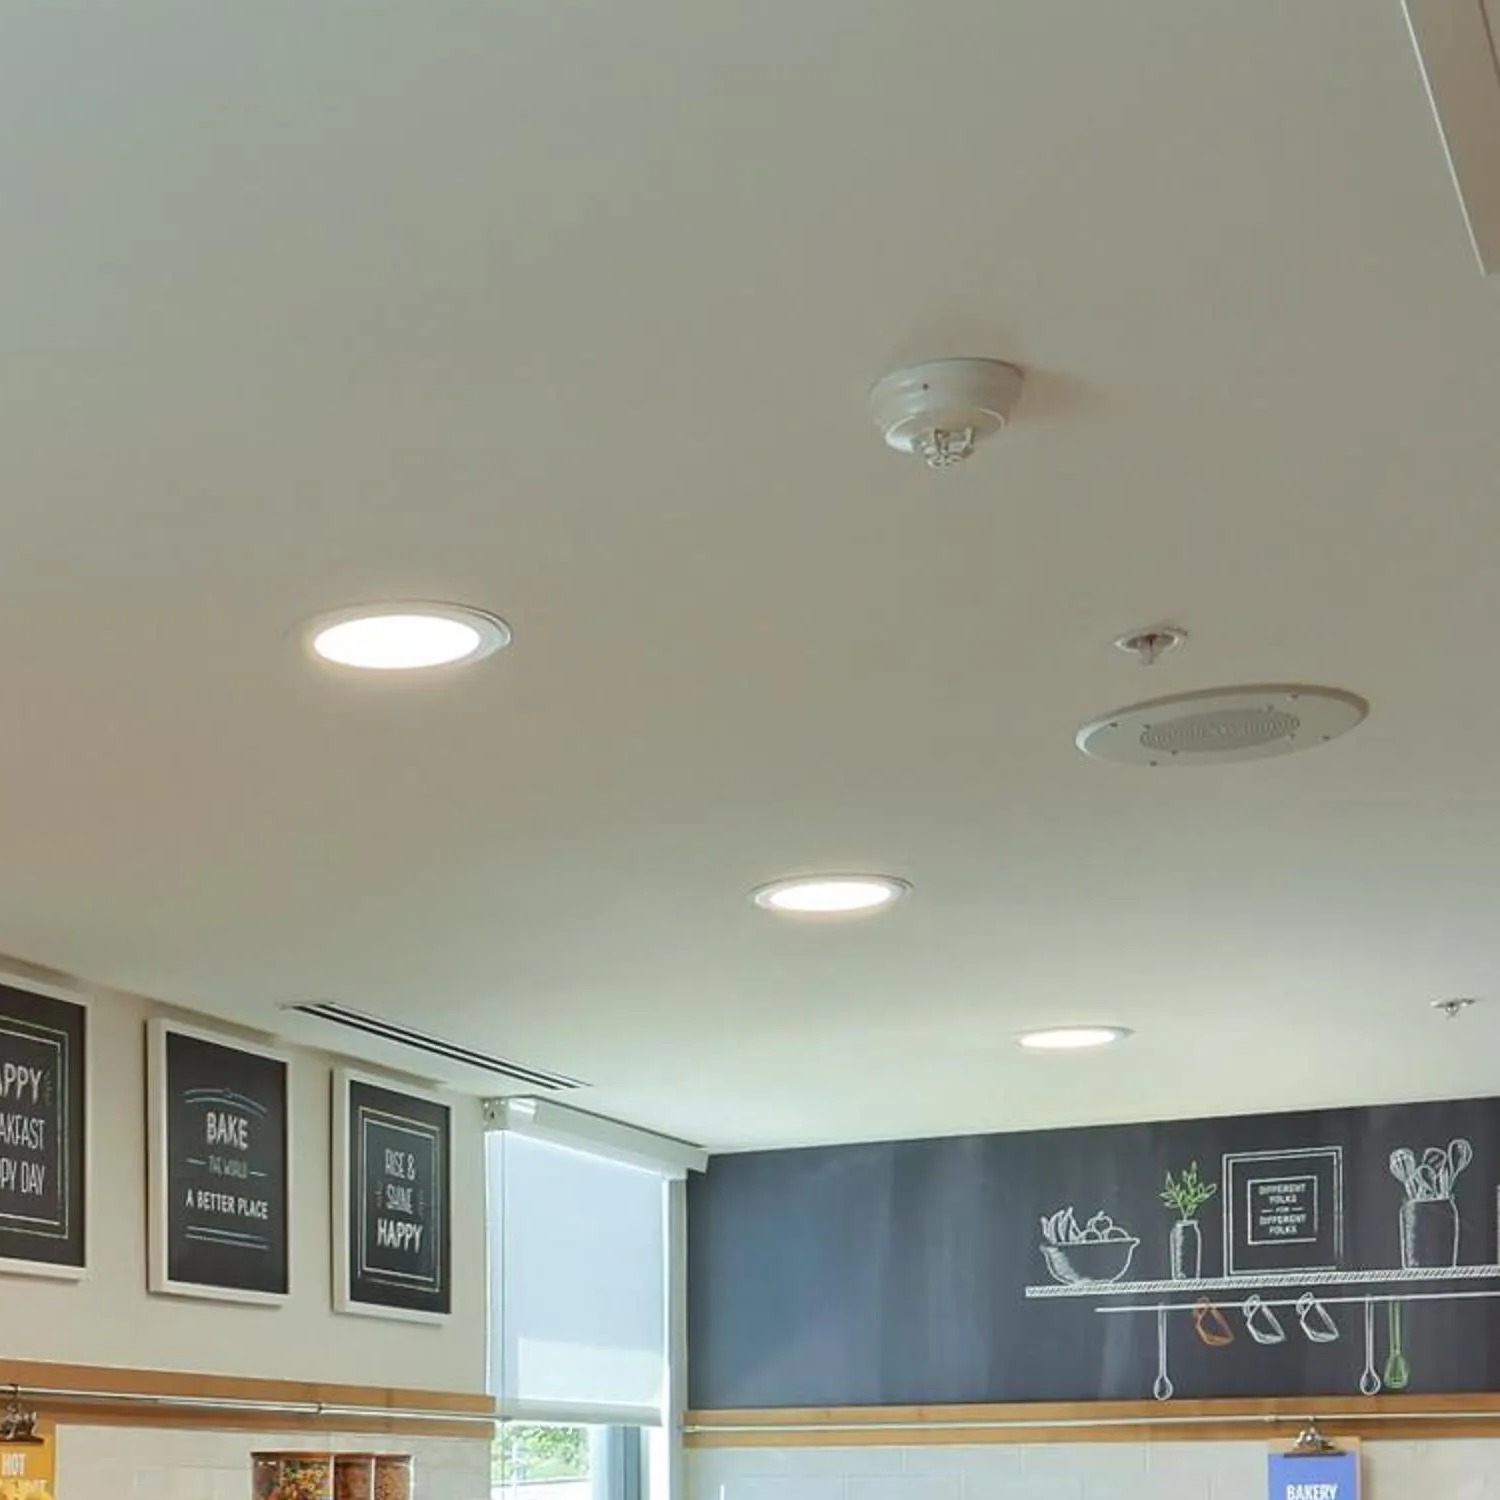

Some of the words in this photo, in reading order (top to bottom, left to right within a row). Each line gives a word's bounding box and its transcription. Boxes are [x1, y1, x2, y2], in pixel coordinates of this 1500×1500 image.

[206, 1111, 249, 1150] BAKE
[21, 1162, 46, 1196] DAY
[185, 1188, 195, 1208] A
[197, 1191, 236, 1215] BETTER
[237, 1197, 269, 1220] PLACE
[378, 1217, 423, 1253] HAPPY
[1, 1452, 26, 1476] HOT
